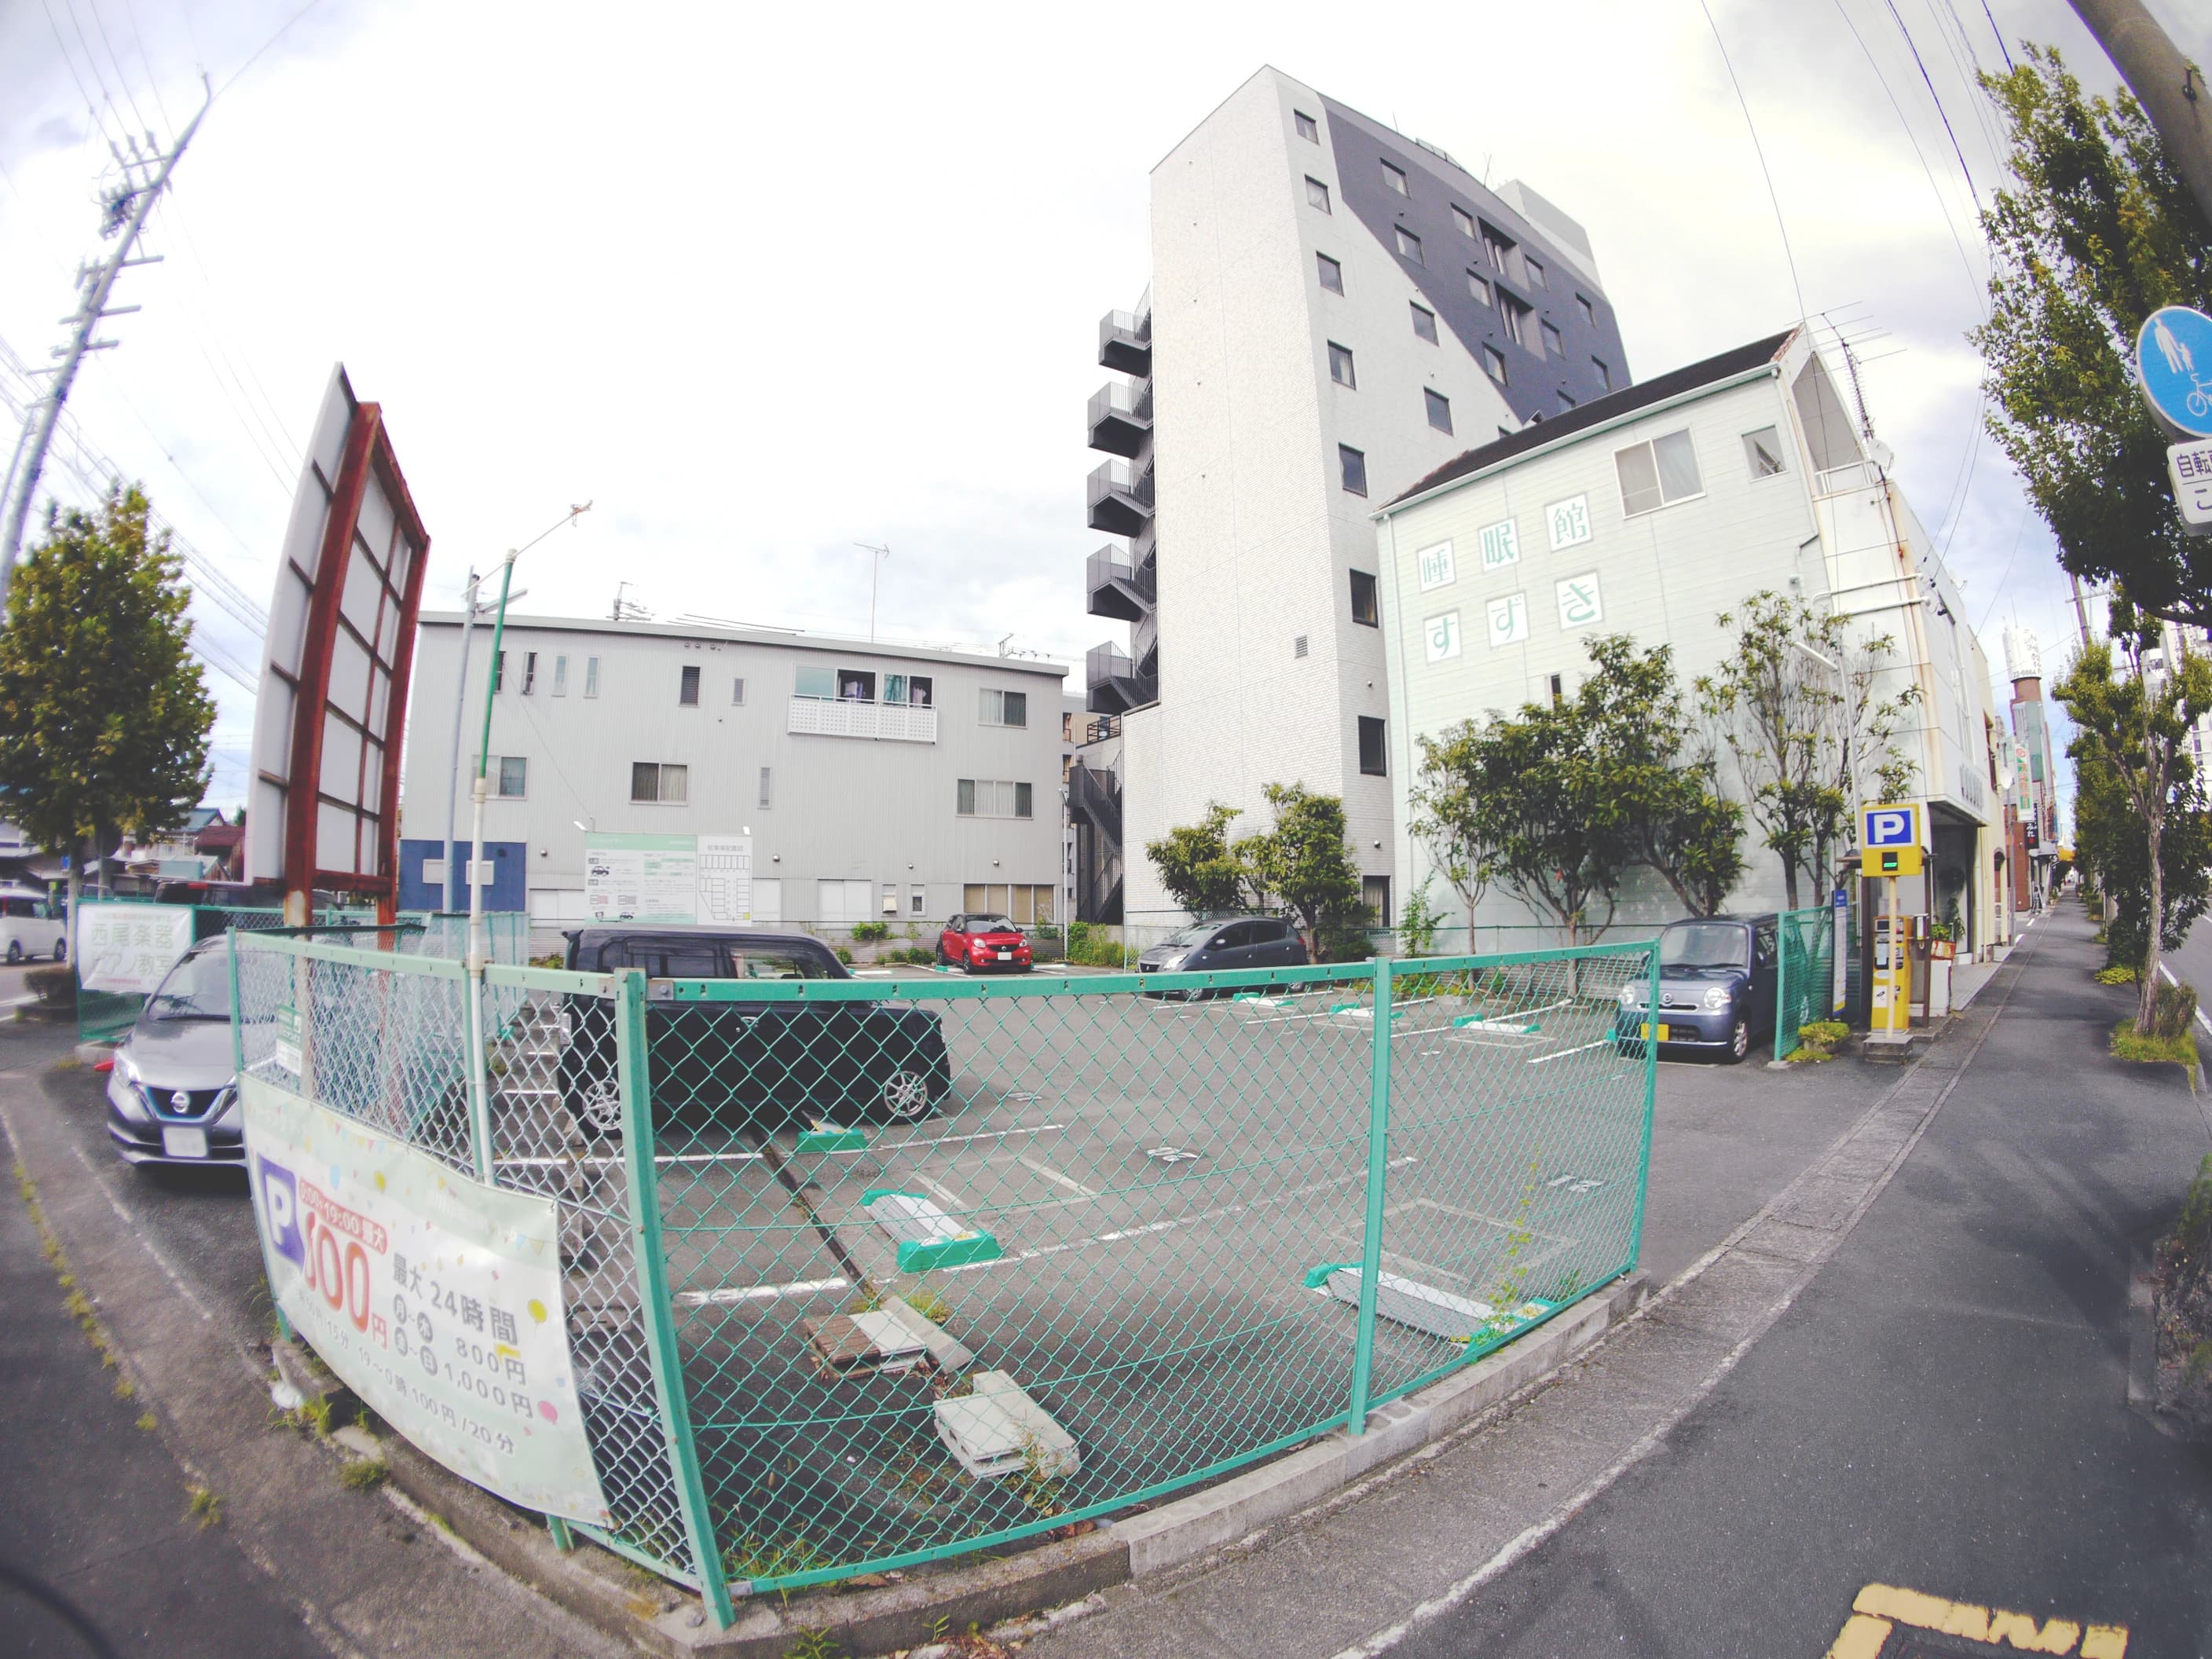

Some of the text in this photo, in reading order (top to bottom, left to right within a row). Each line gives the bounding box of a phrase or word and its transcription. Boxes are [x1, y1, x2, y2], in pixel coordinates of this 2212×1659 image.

[2177, 450, 2212, 478] 自転
[1422, 502, 1587, 584] 睡眠館
[1427, 583, 1595, 657] すずき
[1873, 814, 1905, 844] P
[91, 923, 174, 950] 西尾楽器
[265, 1174, 292, 1247] P
